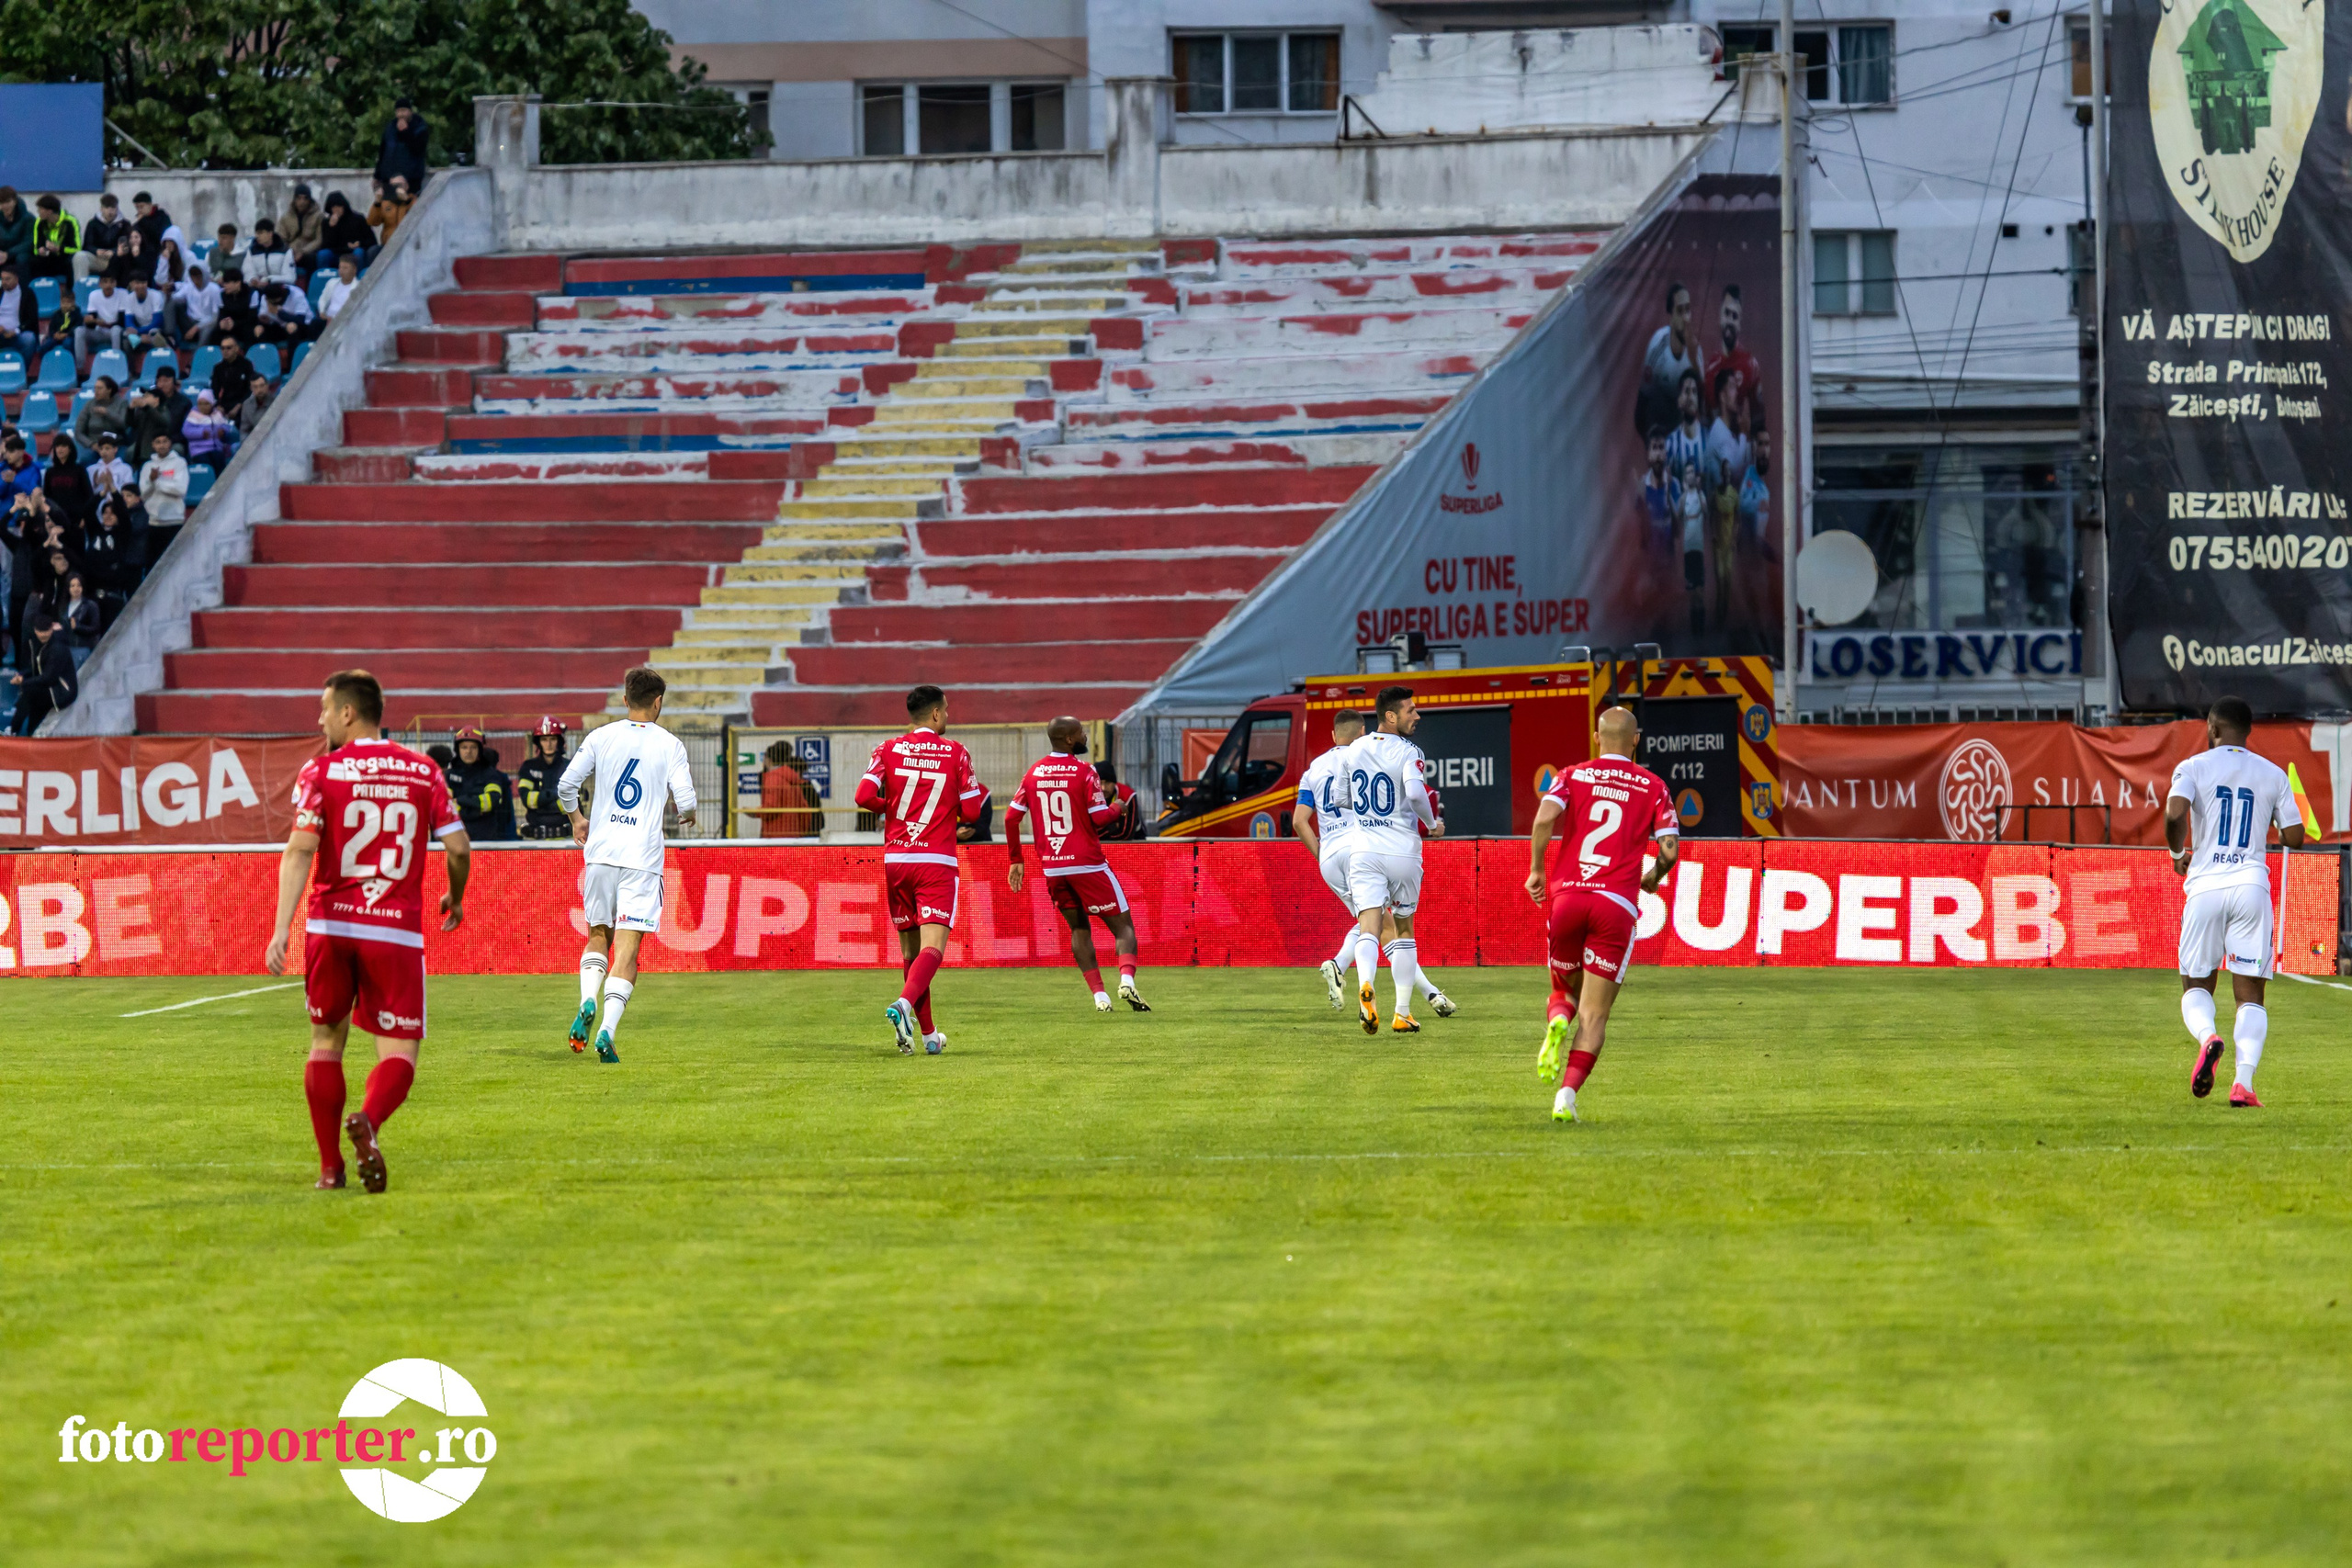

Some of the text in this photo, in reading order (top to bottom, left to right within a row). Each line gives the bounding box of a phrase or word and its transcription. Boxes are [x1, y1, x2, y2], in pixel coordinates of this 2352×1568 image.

[2236, 157, 2285, 247] HOUSE
[2121, 309, 2156, 341] VĂ
[2286, 315, 2331, 341] DRAG!
[2147, 360, 2217, 384] Strada
[2299, 362, 2328, 389] 172,
[2168, 394, 2268, 423] Zăicești,
[1441, 491, 1503, 514] SUPERLIGA
[2168, 484, 2320, 519] REZERVĂRI
[2169, 534, 2352, 570] 075540020
[1425, 555, 1522, 597] CU TINE,
[1356, 598, 1590, 645] SUPERLIGA E SUPER
[902, 740, 953, 751] Regata.ro
[1646, 733, 1724, 753] POMPIERII
[343, 756, 431, 776] Regata.ro
[902, 757, 942, 770] MILANOV
[1039, 764, 1079, 774] Regata.ro
[1586, 767, 1651, 785] Regata.ro
[1680, 762, 1704, 779] 112
[352, 784, 410, 800] PATRICHE
[614, 758, 643, 810] 6
[894, 768, 947, 825] 77
[1351, 769, 1396, 817] 30
[1592, 785, 1630, 802] MOURA
[610, 814, 638, 826] DICAN
[1036, 791, 1073, 835] 19
[1327, 820, 1348, 832] MIRON
[2216, 785, 2255, 848] 11
[340, 799, 419, 881] 23
[1578, 799, 1623, 866] 2
[2213, 852, 2246, 864] REAGY
[0, 874, 163, 968] BE
[356, 906, 402, 919] GAMING
[1595, 955, 1618, 971] Tehnic
